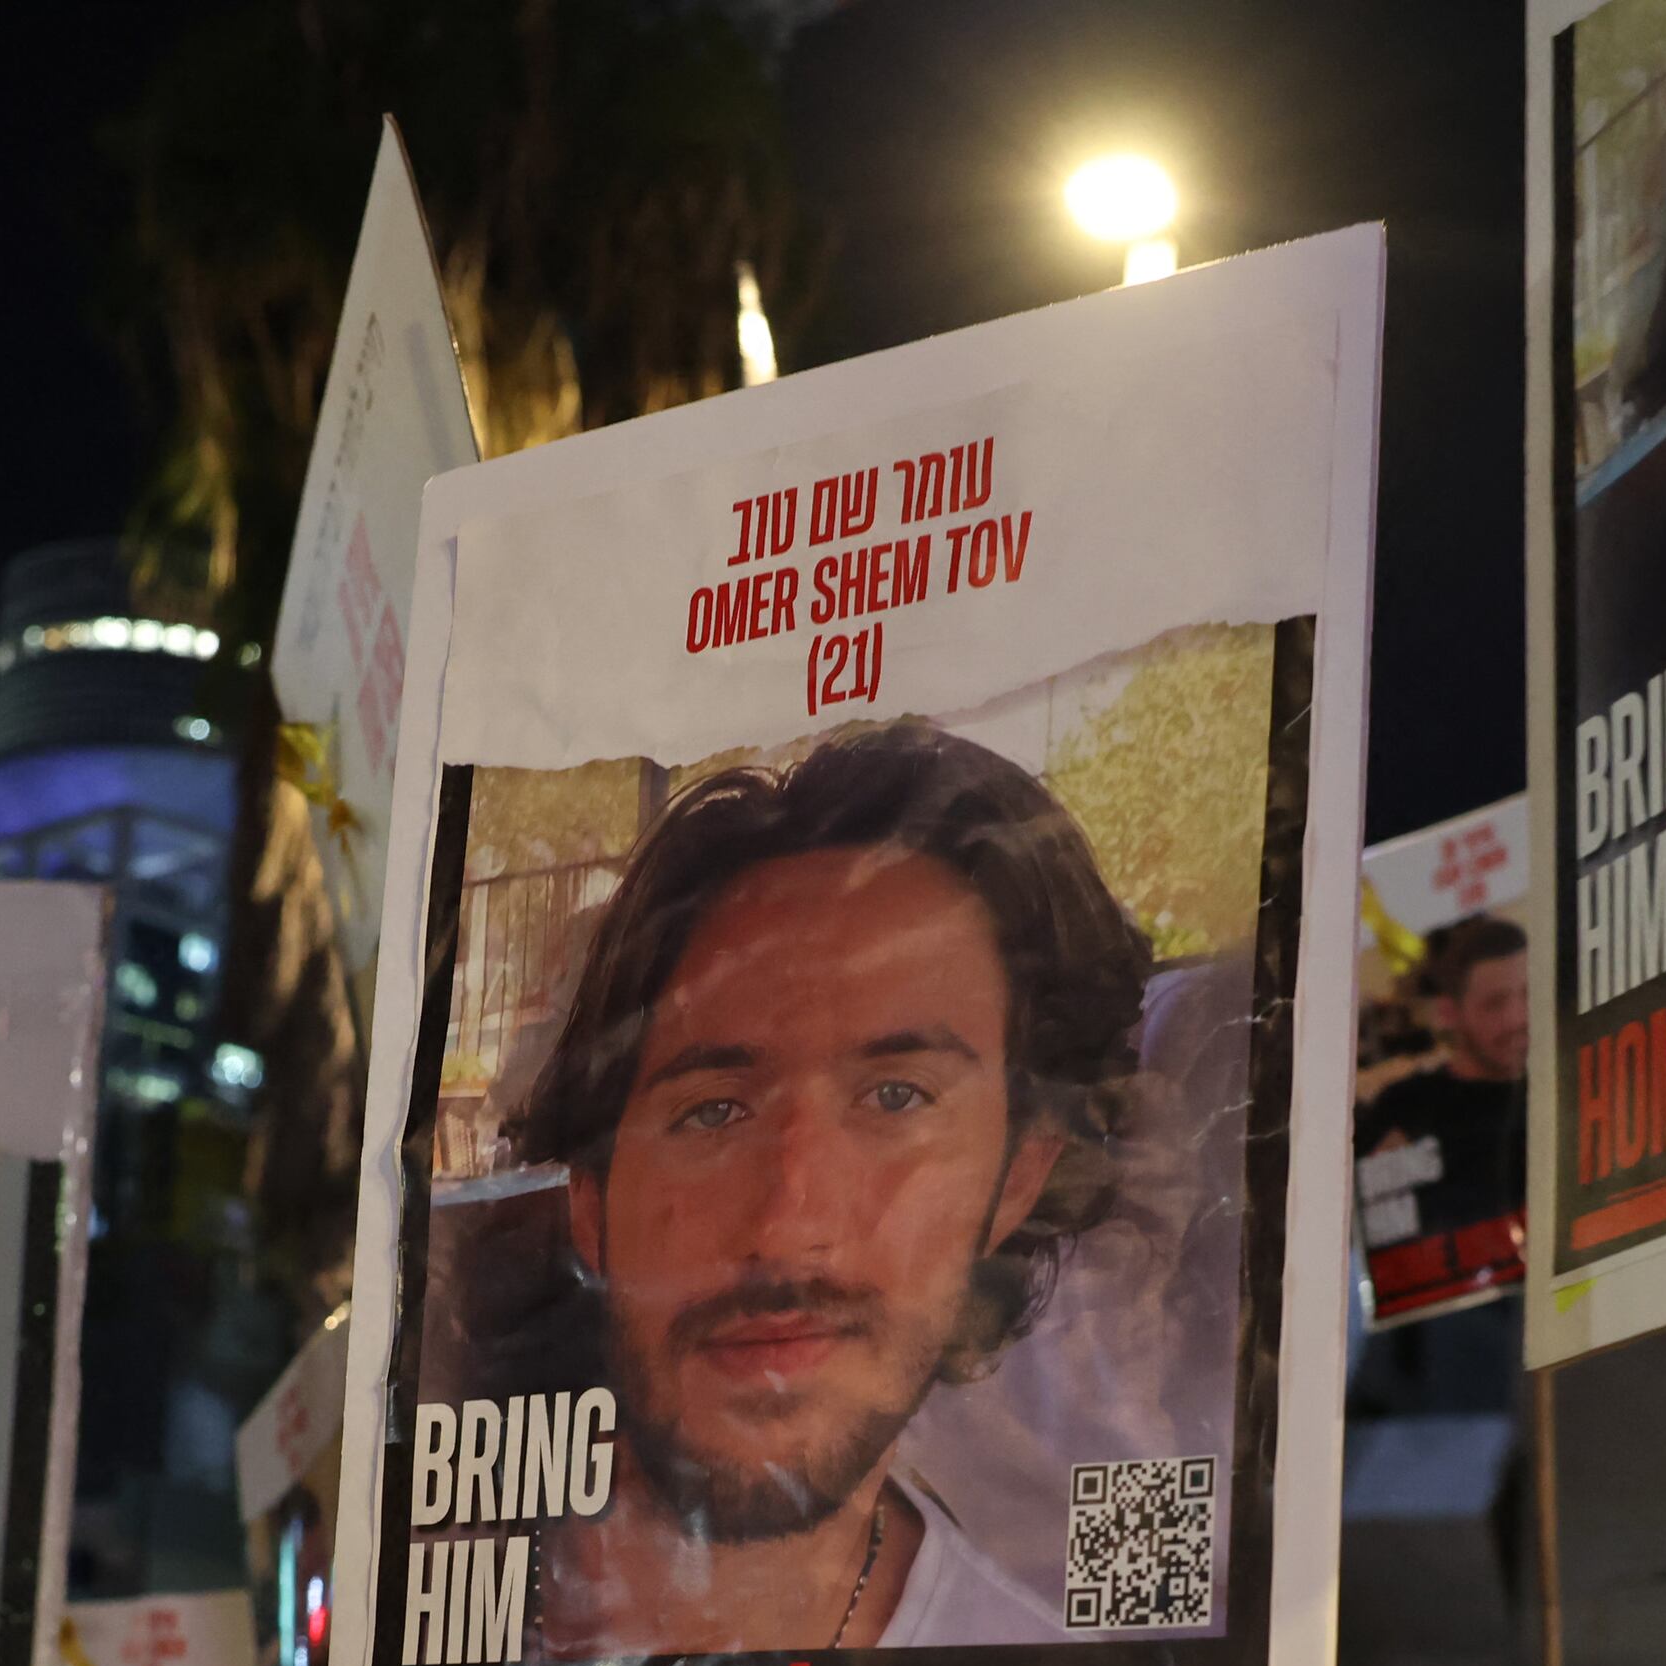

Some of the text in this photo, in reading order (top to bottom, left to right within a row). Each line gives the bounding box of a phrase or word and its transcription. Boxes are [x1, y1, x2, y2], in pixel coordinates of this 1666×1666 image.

[727, 436, 994, 567] עומר שם טוב
[685, 510, 1033, 654] OMER SHEM TOV
[806, 622, 883, 716] (21)
[411, 1386, 618, 1527] BRING
[402, 1535, 530, 1666] HIM
